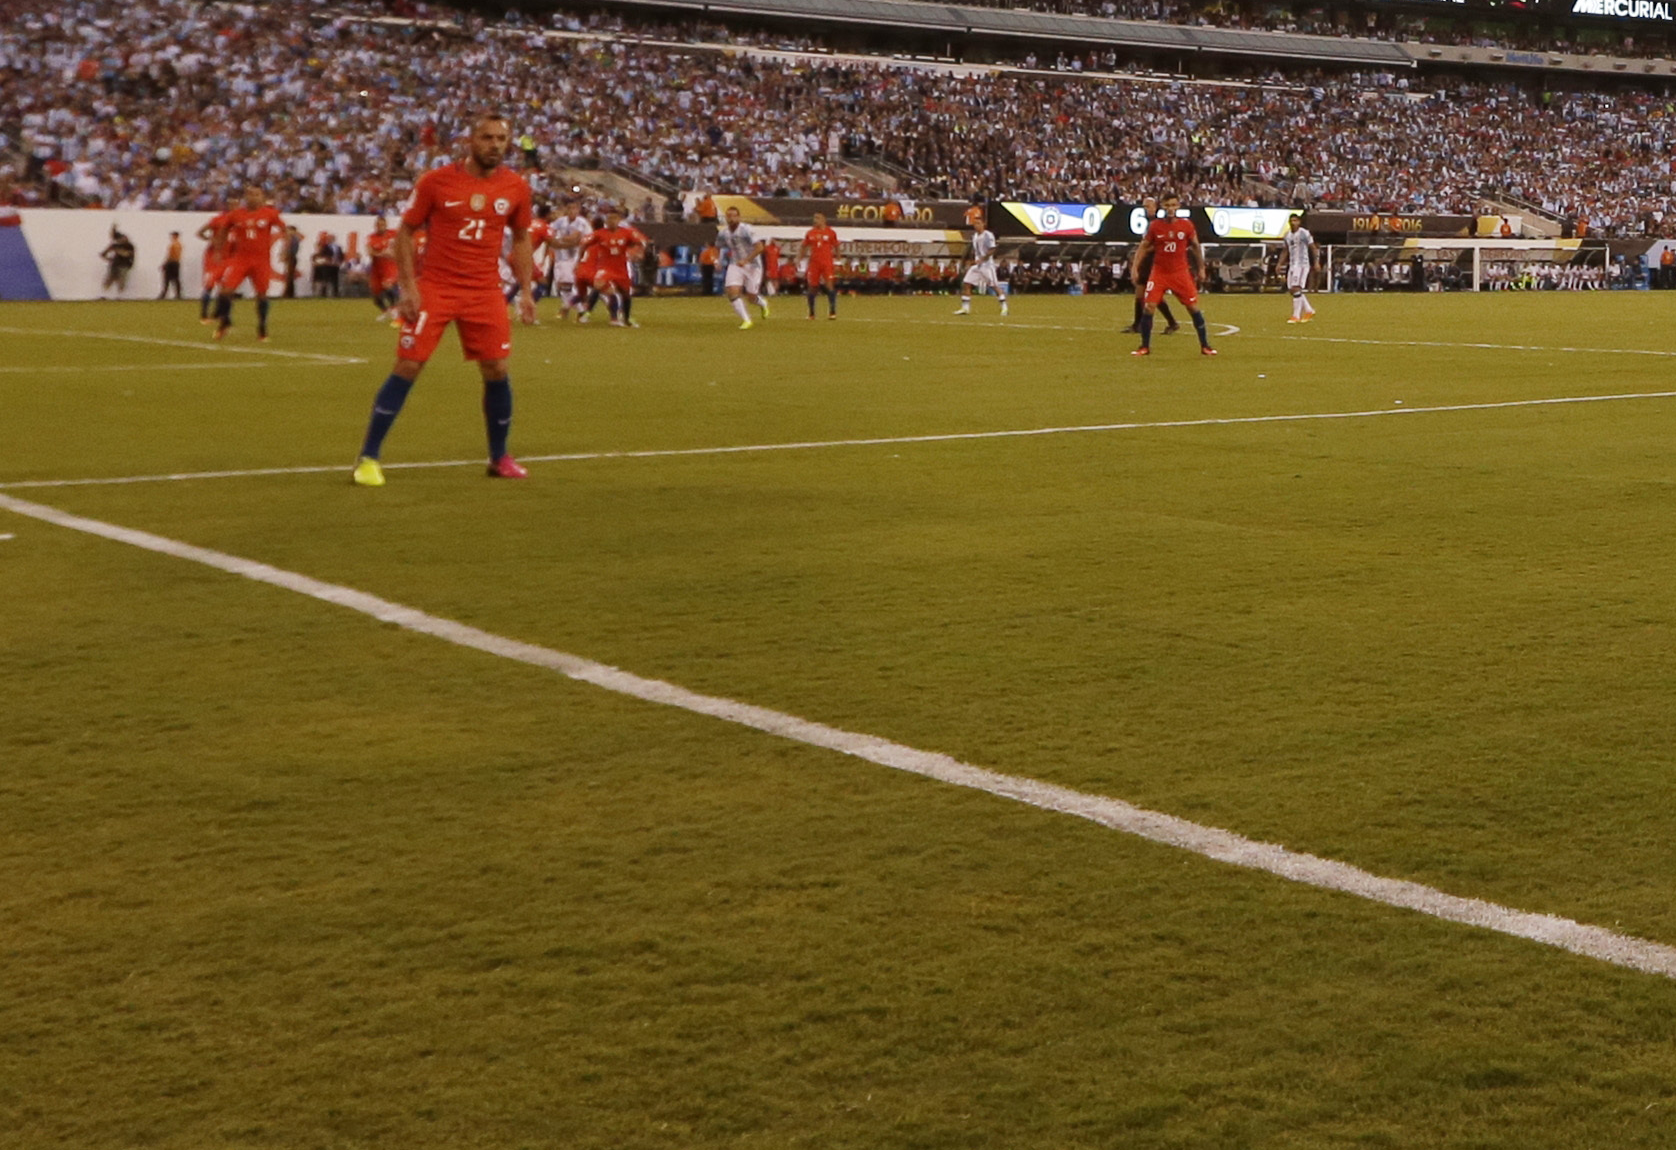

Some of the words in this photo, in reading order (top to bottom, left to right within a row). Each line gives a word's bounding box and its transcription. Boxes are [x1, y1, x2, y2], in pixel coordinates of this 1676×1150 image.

[459, 218, 486, 241] 21
[1083, 211, 1101, 234] 0
[1213, 210, 1230, 236] 0
[1353, 217, 1373, 232] 191
[1401, 217, 1423, 232] 016
[414, 310, 428, 335] 1
